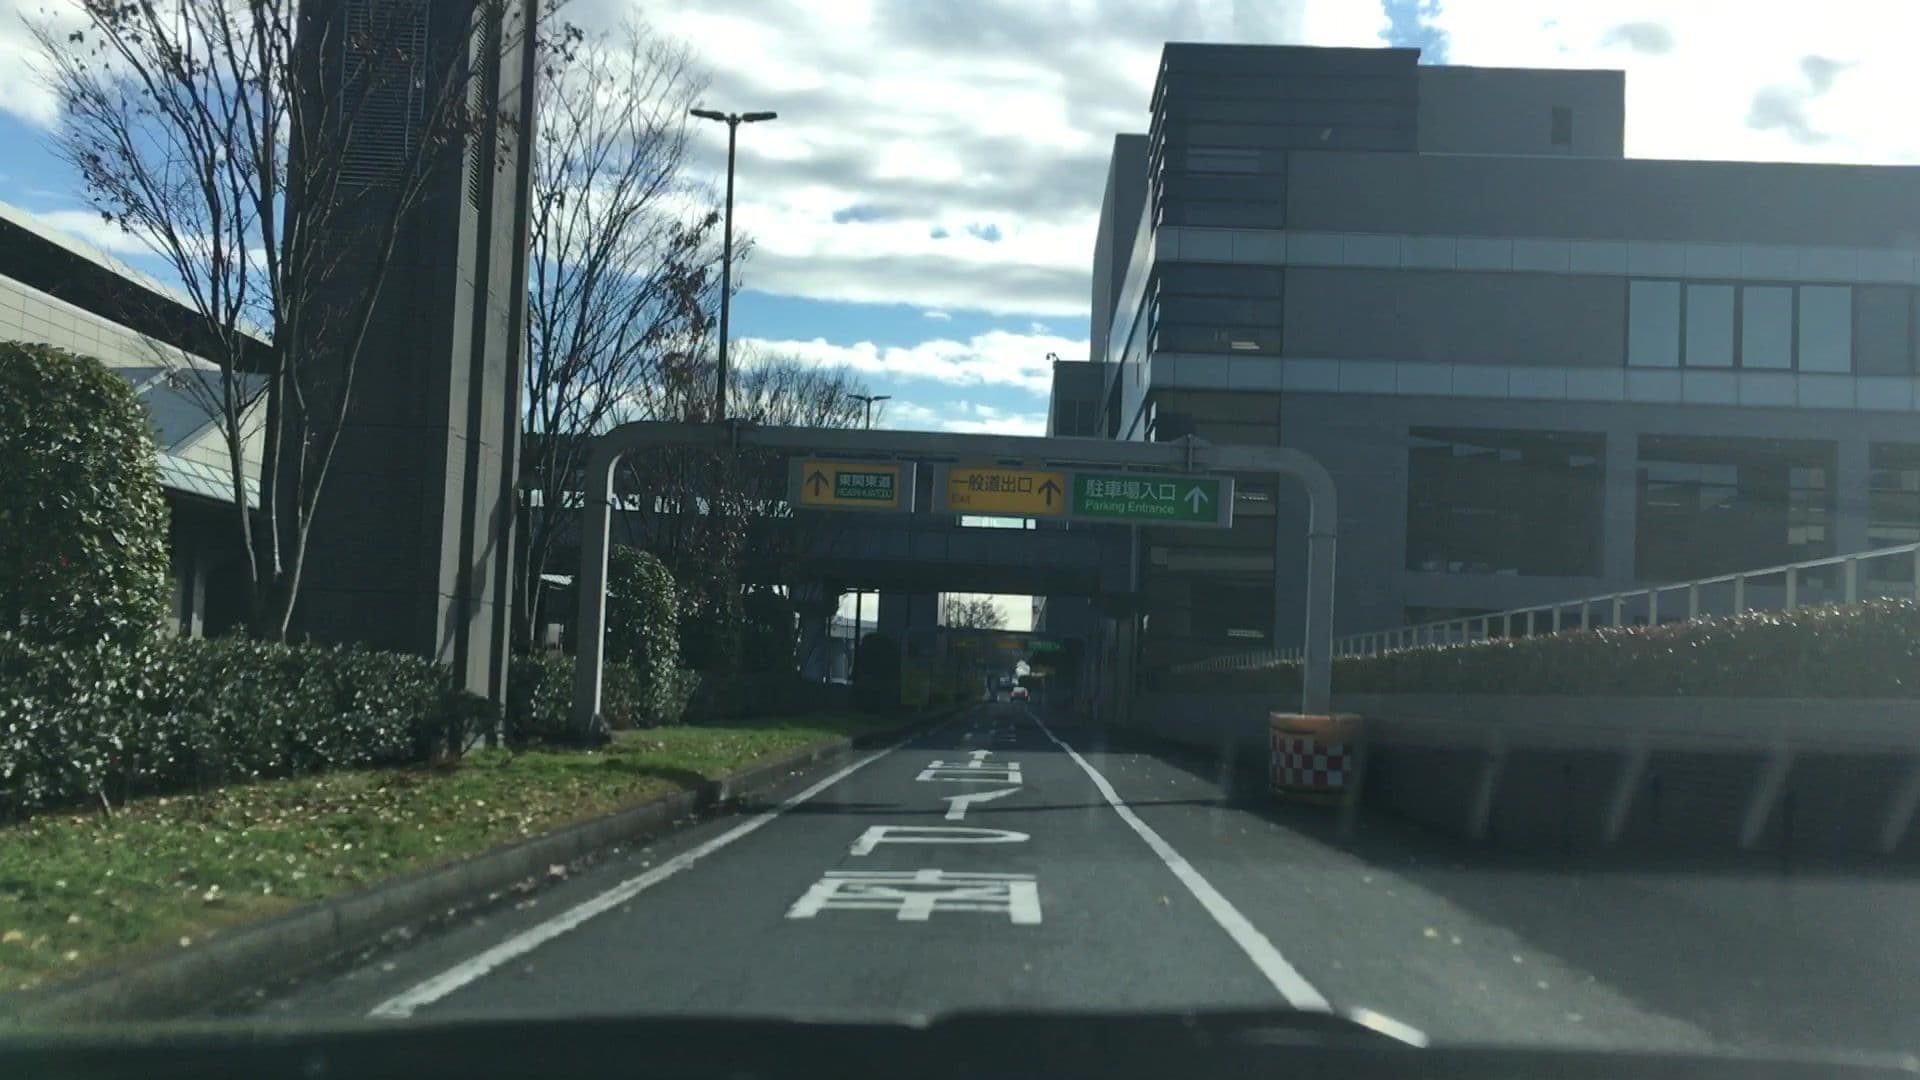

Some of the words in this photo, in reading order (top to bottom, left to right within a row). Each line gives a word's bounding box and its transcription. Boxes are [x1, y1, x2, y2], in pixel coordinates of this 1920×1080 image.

[839, 473, 891, 489] 東関東道
[951, 473, 1033, 493] 一般道出口
[1086, 479, 1176, 501] 駐車場入口
[1085, 499, 1125, 513] Parking
[1128, 501, 1175, 514] Entrance
